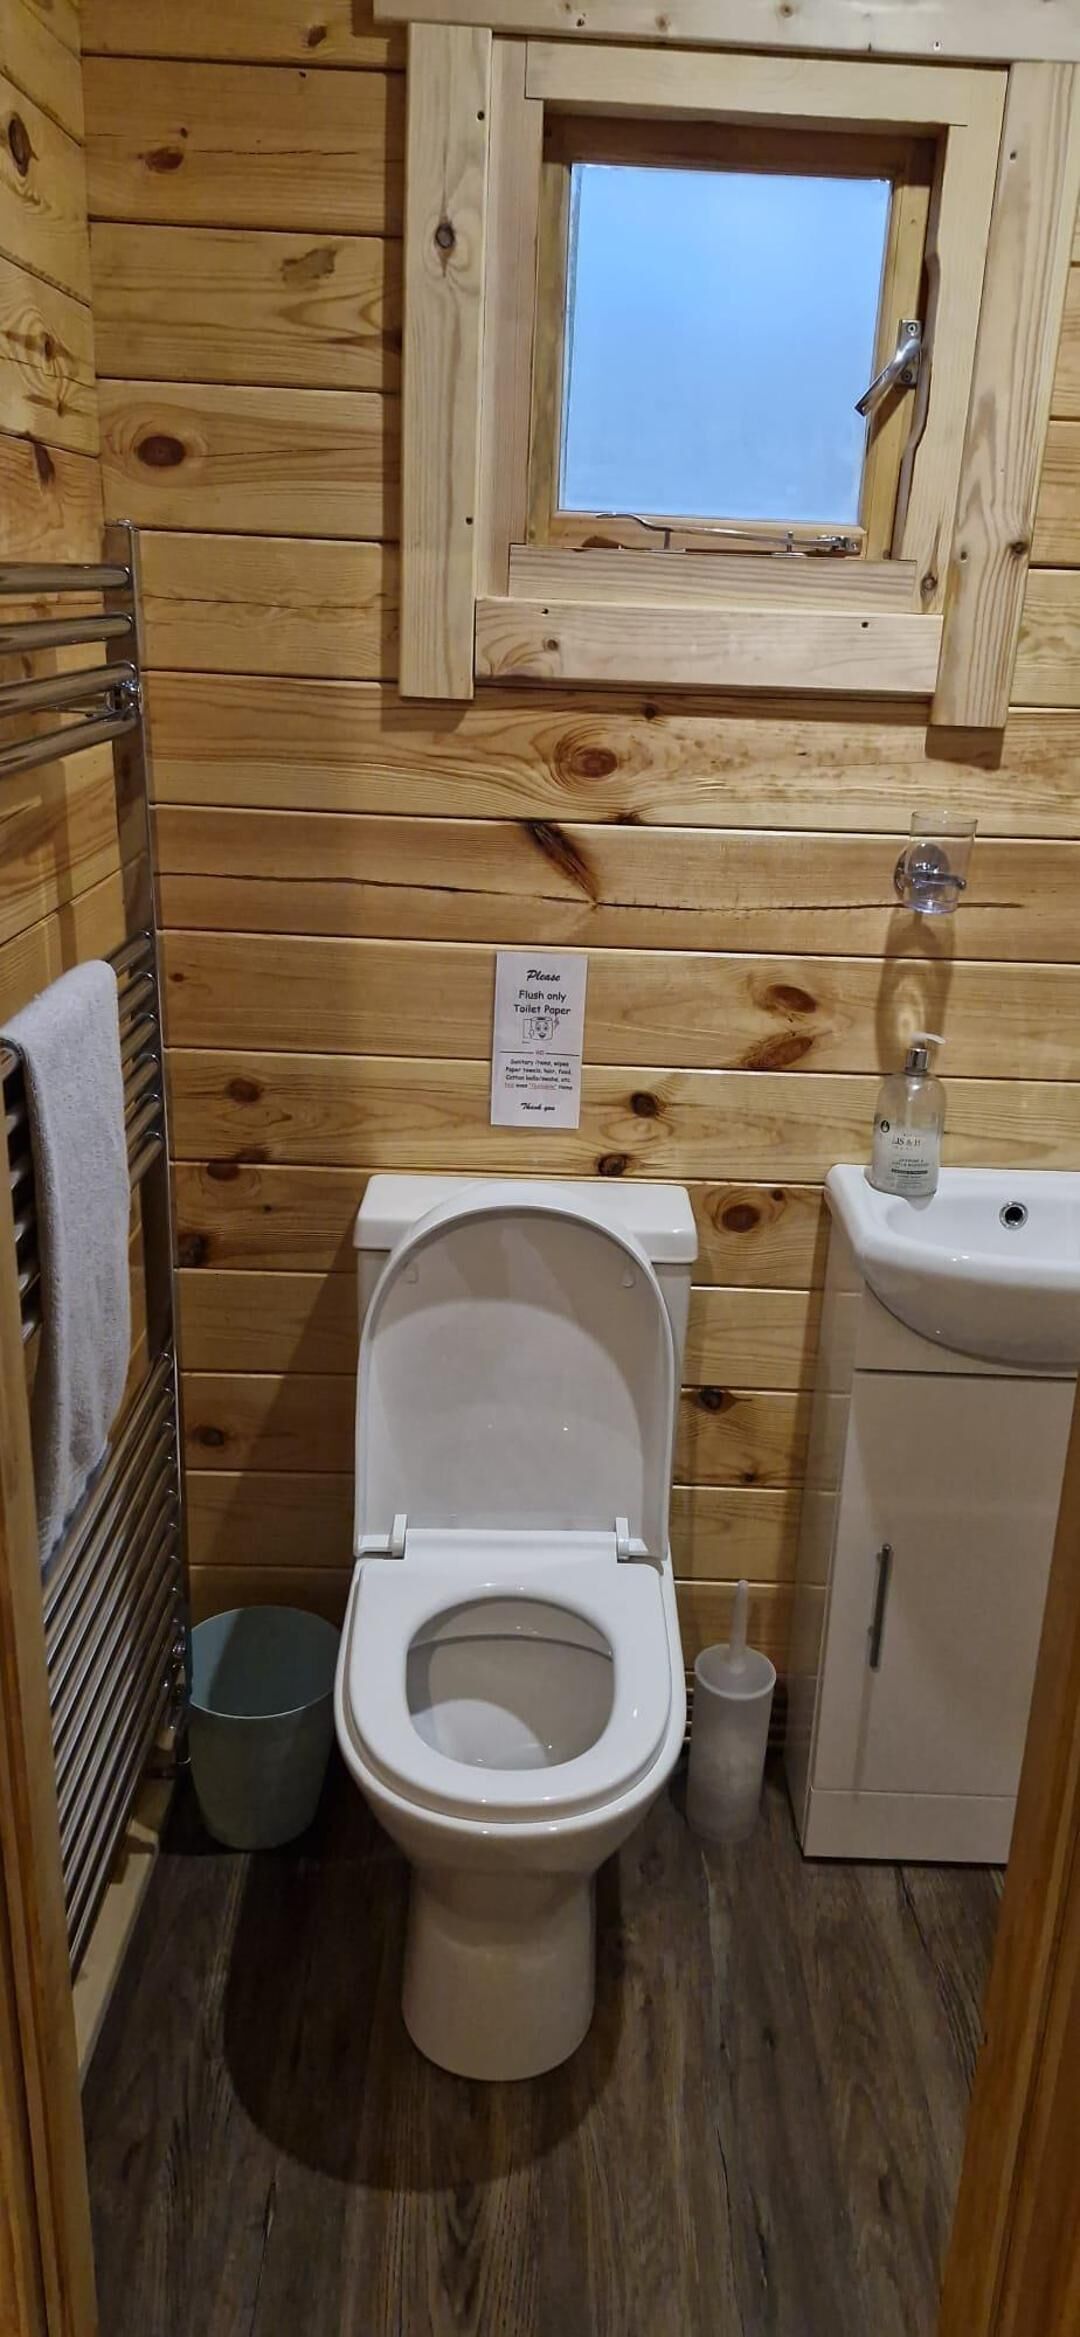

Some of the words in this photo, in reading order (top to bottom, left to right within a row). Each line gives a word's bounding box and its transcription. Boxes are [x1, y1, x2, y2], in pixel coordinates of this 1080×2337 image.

[526, 969, 561, 982] Please
[518, 989, 545, 1000] Flush
[546, 991, 567, 1003] only
[513, 1004, 541, 1014] Toilet
[544, 1004, 571, 1016] Paper
[520, 1102, 542, 1110] Thank
